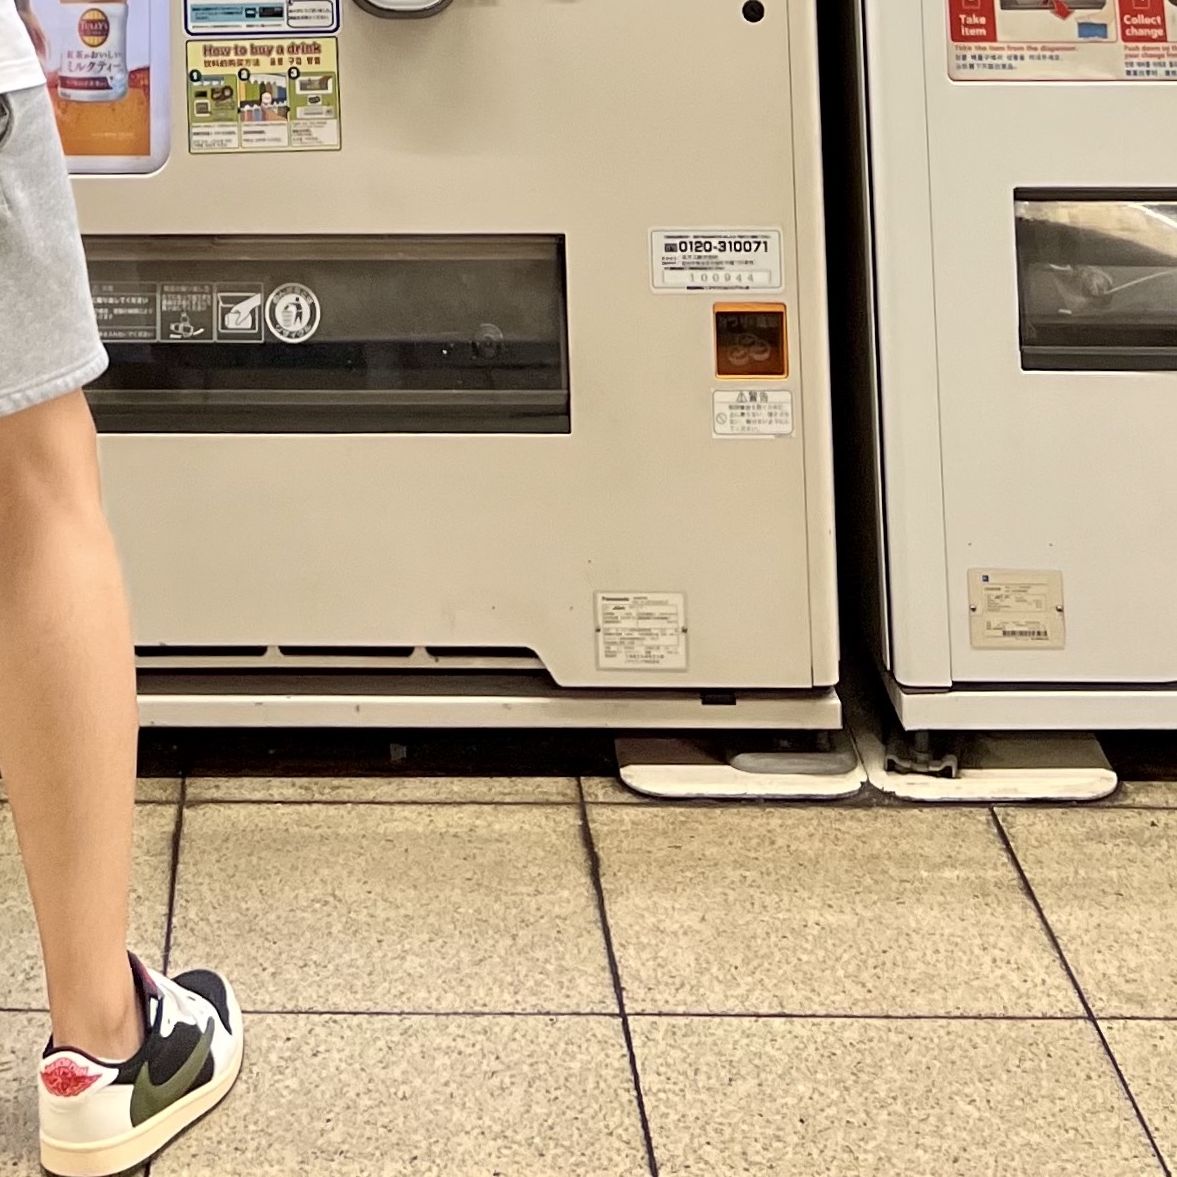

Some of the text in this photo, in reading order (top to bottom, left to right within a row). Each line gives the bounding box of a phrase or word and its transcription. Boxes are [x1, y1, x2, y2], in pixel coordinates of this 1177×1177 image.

[959, 14, 987, 25] Take
[1123, 14, 1162, 25] Collect
[961, 25, 987, 36] item
[1125, 26, 1164, 39] change
[203, 41, 322, 58] How to buy a drink
[679, 240, 768, 253] 0120-310071
[689, 272, 755, 283] 100944
